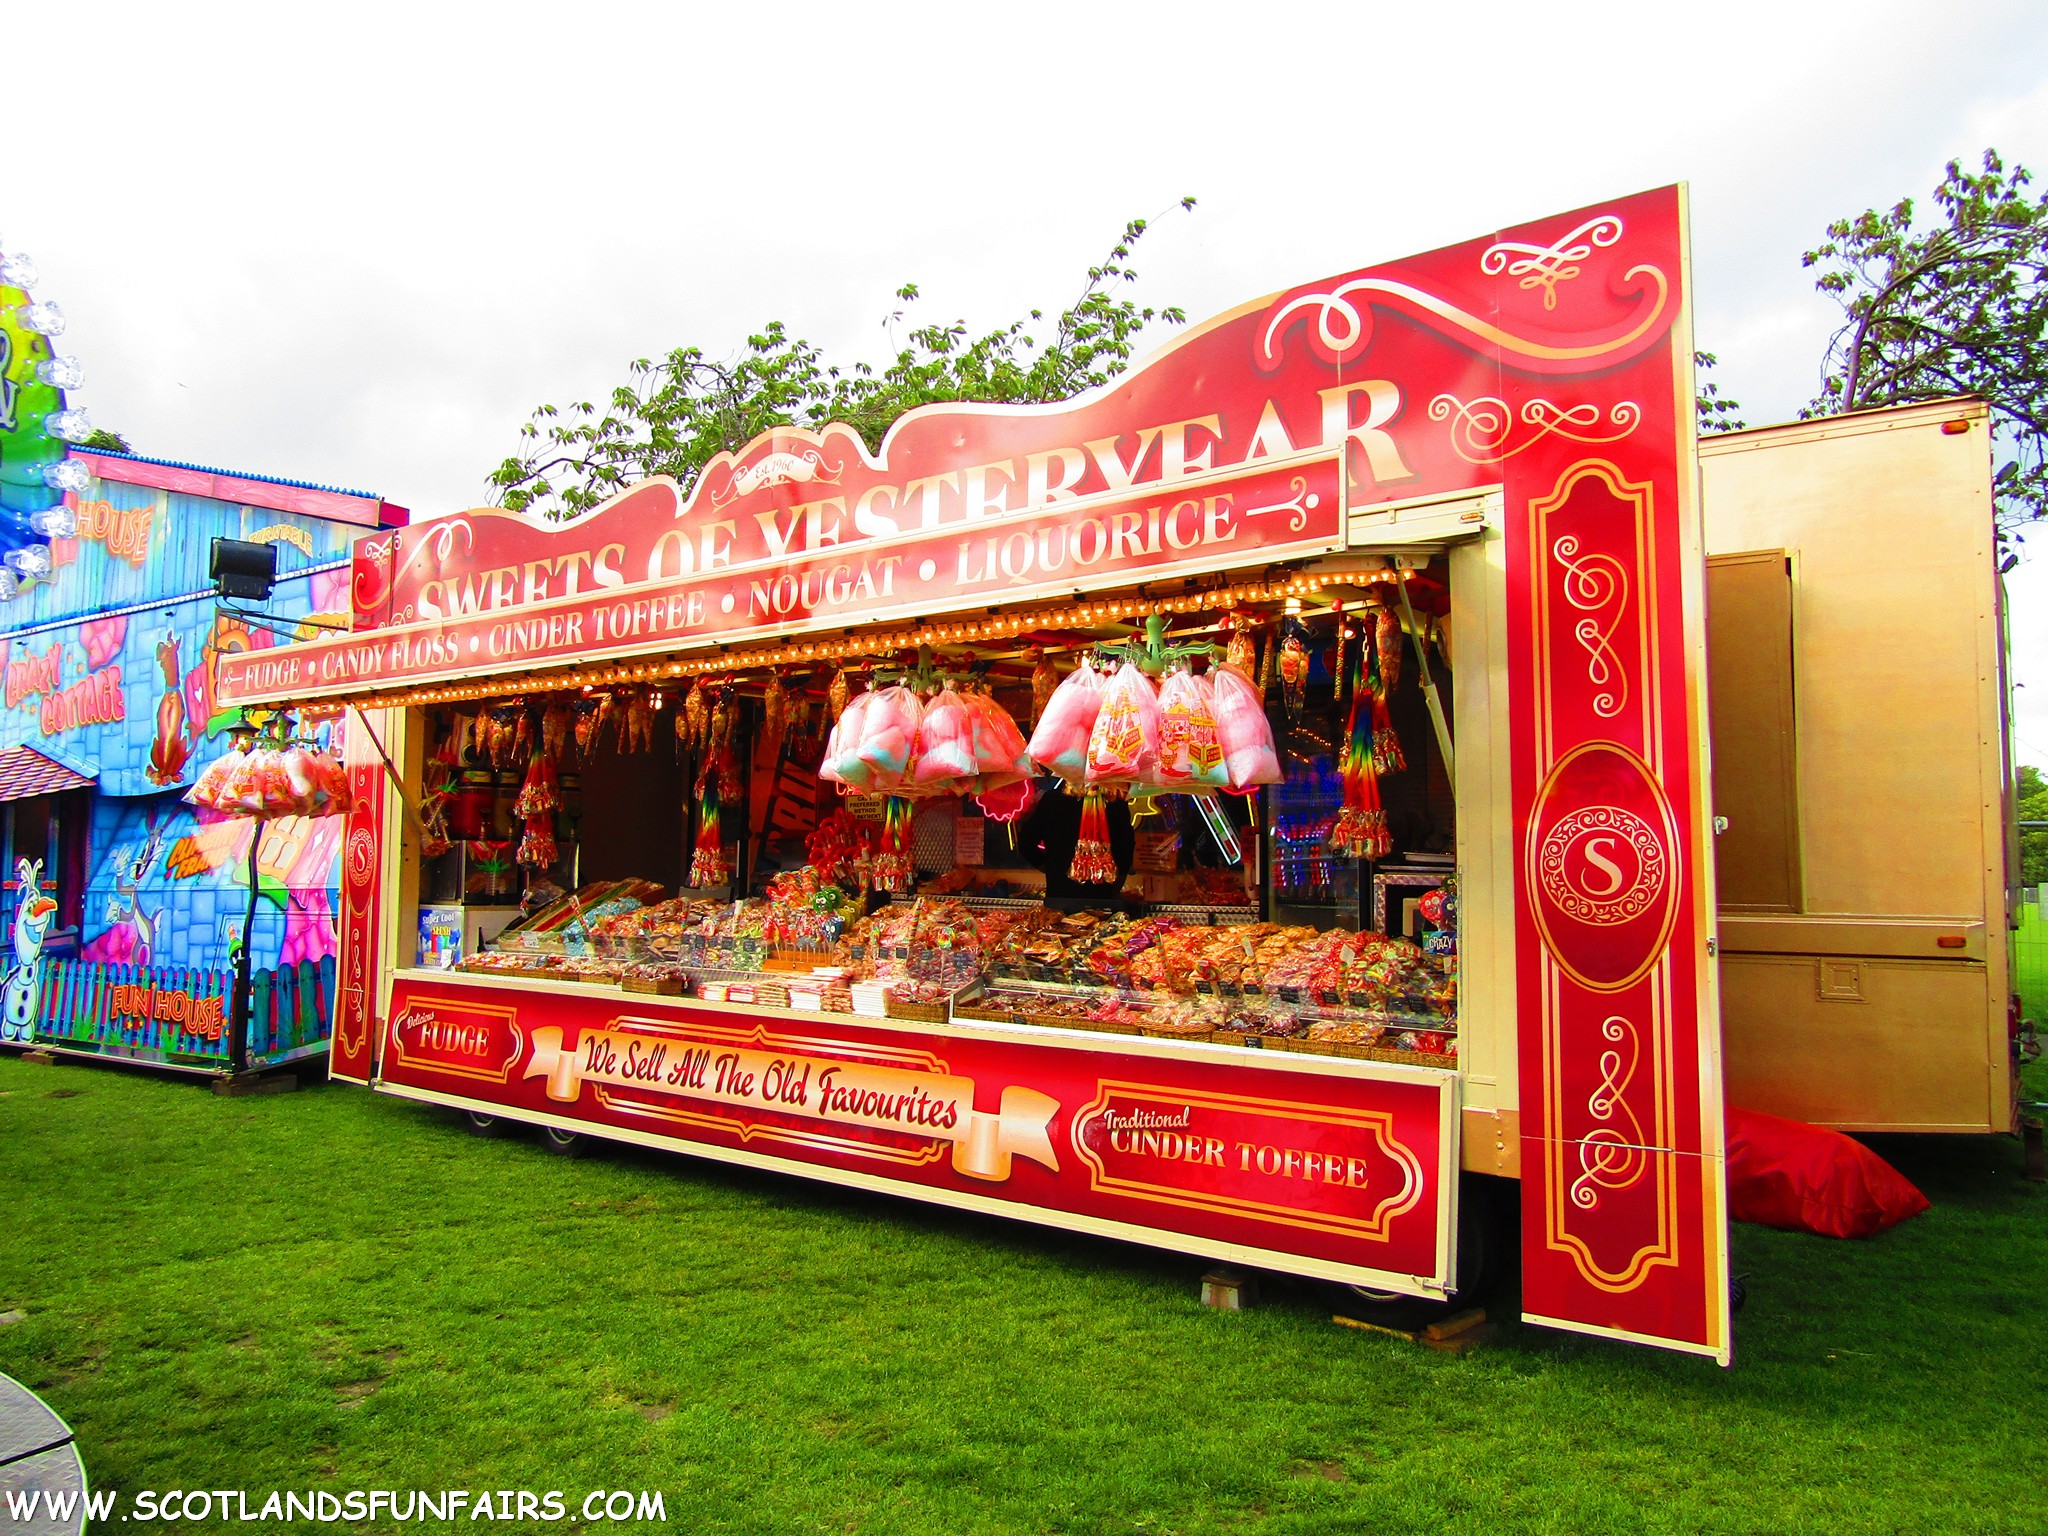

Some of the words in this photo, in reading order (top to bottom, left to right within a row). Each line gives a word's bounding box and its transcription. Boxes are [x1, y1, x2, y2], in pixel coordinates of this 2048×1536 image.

[754, 464, 770, 479] Est.
[772, 458, 795, 472] 1960
[77, 499, 155, 568] HOUSE
[244, 657, 301, 691] FUDGE
[321, 643, 388, 680] CANDY
[390, 631, 460, 671] FLOSS
[488, 611, 583, 657] CINDER
[591, 590, 706, 641] TOFFEE
[746, 555, 902, 619] NOUGAT
[955, 493, 1239, 586] LIQUORICE
[417, 543, 626, 621] SWEETS
[648, 519, 738, 582] OF
[6, 641, 63, 708] CRAZY
[40, 664, 126, 735] COTTAGE
[355, 843, 366, 872] S
[1580, 837, 1623, 896] S
[1428, 935, 1453, 950] CRAZY
[111, 984, 152, 1019] FUN
[154, 990, 224, 1040] HOUSE
[407, 1011, 435, 1030] Delicious
[419, 1020, 490, 1057] FUDGE
[585, 1035, 616, 1075] We
[622, 1040, 667, 1082] Sell
[667, 1048, 710, 1089] All
[715, 1053, 754, 1097] The
[762, 1059, 811, 1106] Old
[818, 1067, 957, 1129] Favourites
[1104, 1106, 1190, 1130] Traditional
[1110, 1129, 1226, 1168] CINDER
[1235, 1141, 1369, 1189] TOFFEE
